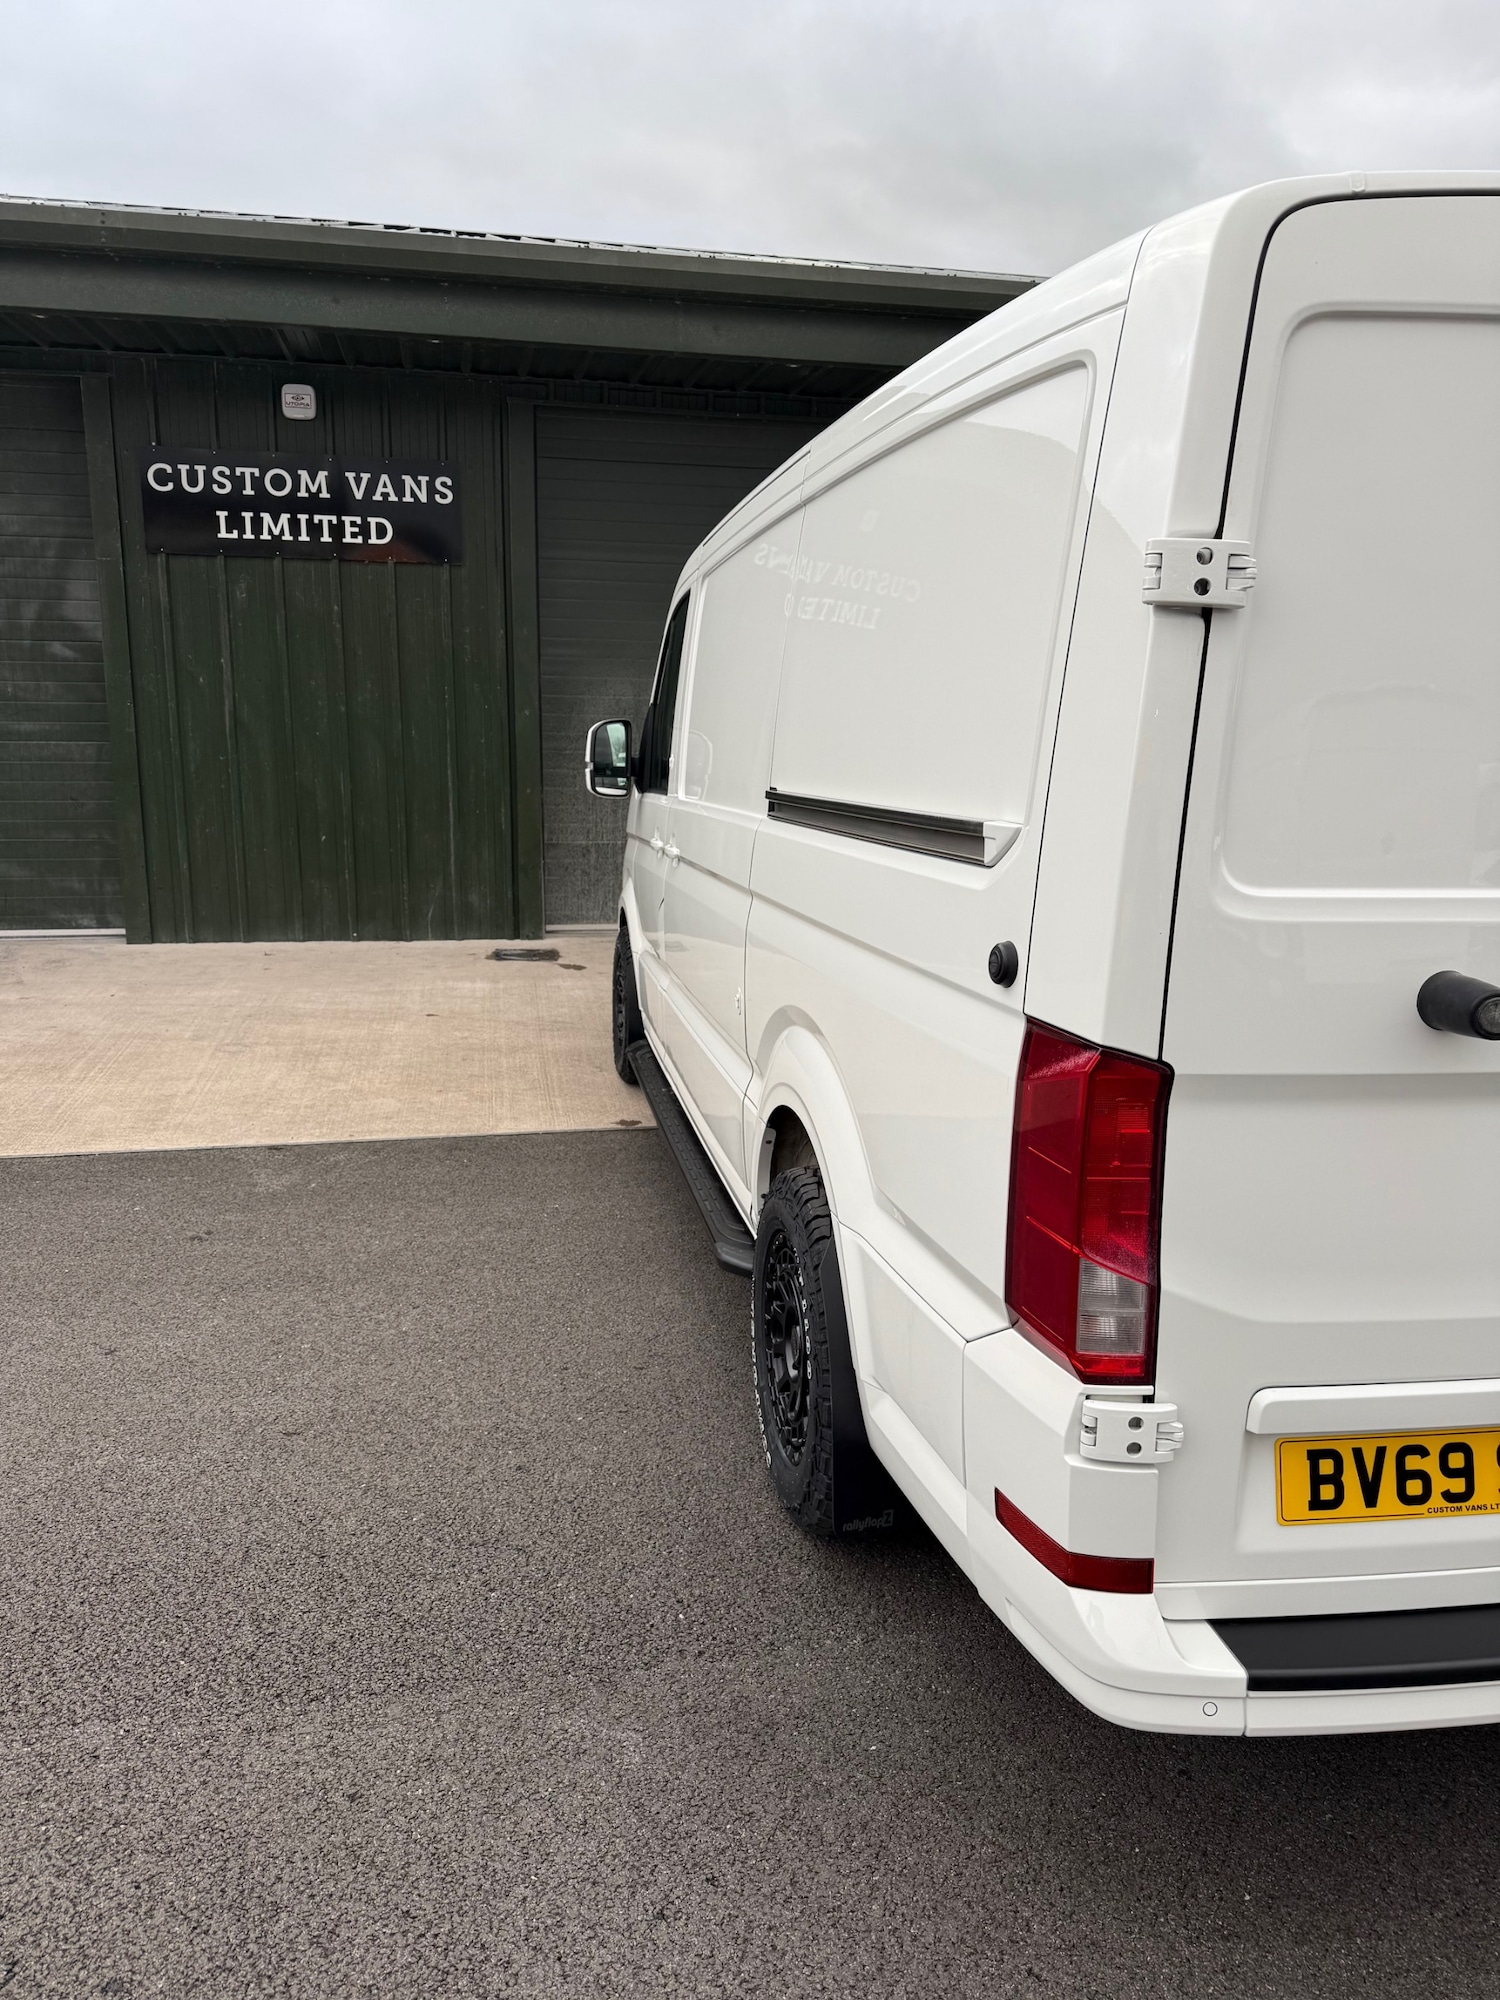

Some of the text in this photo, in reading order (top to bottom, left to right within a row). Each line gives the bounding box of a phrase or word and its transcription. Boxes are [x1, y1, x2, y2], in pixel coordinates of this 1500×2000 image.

[146, 462, 454, 505] CUSTOM VANS
[215, 510, 394, 545] LIMITED
[1306, 1441, 1475, 1511] BV69
[1427, 1505, 1463, 1514] CUSTOM
[1465, 1503, 1488, 1512] VANS
